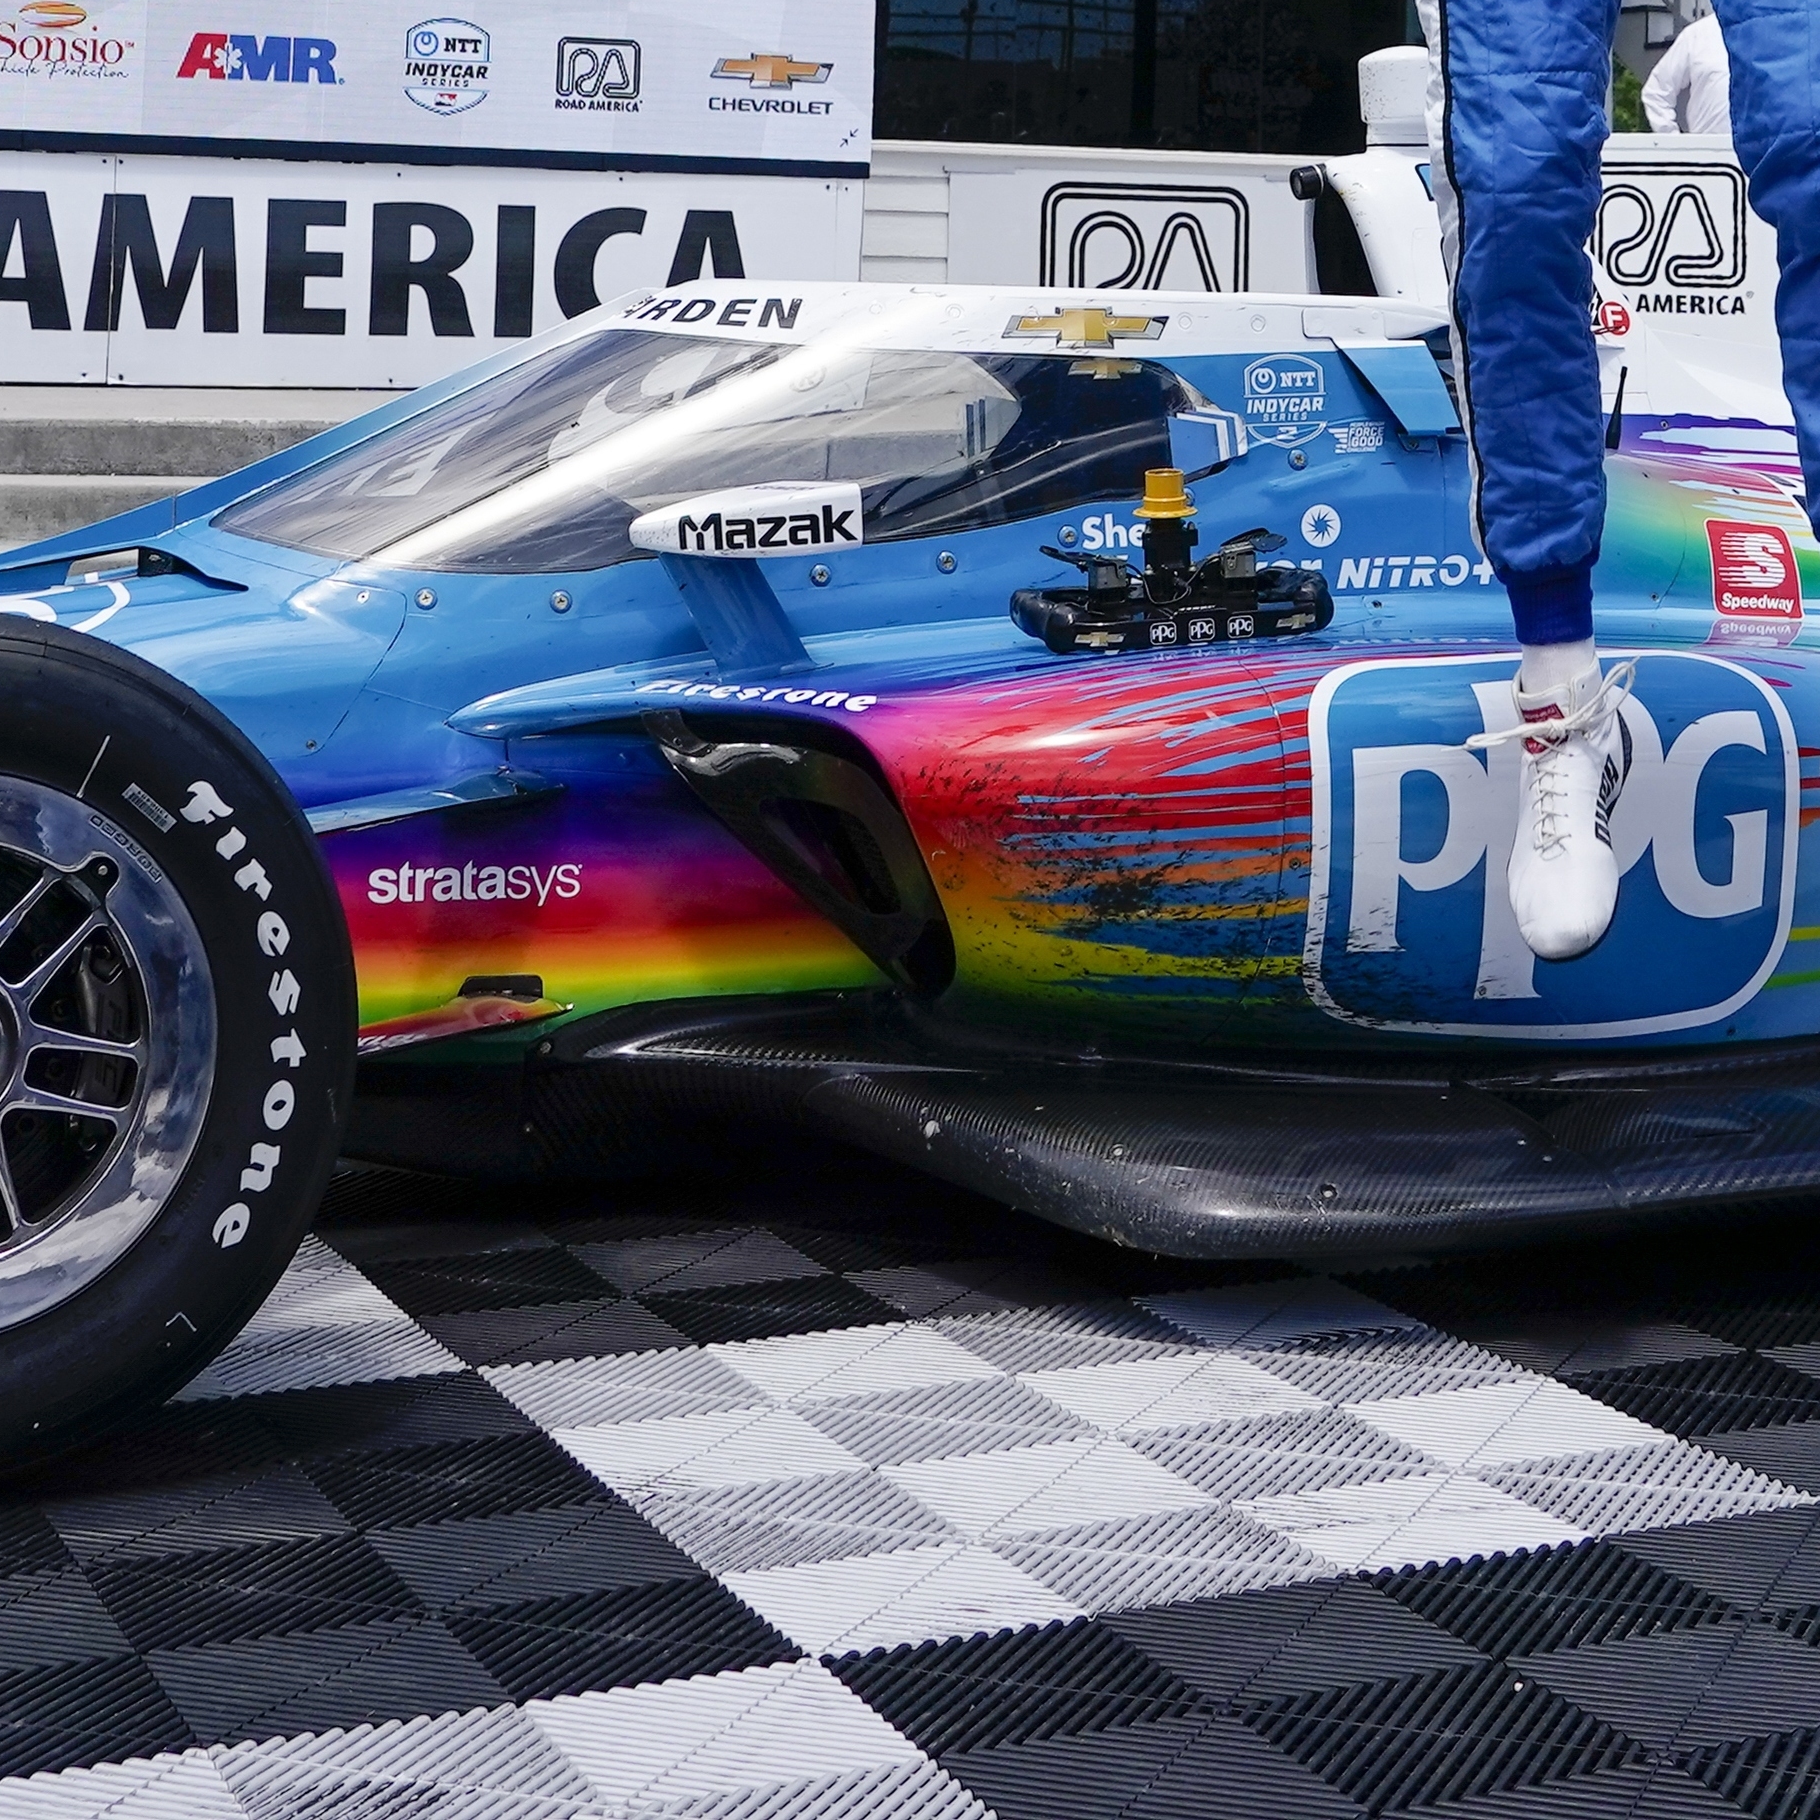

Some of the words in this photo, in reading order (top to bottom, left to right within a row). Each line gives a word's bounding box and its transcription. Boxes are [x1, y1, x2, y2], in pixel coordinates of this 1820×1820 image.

[444, 38, 482, 53] NTT
[176, 33, 336, 84] AMR
[406, 63, 488, 80] INDYCAR
[555, 99, 586, 110] ROAD
[588, 100, 639, 112] AMERICA
[709, 97, 833, 114] CHEVROLET
[1636, 294, 1746, 315] AMERICA
[1280, 371, 1316, 387] NTT
[1247, 397, 1324, 414] INDYCAR
[1263, 411, 1307, 422] SERIES
[1349, 426, 1385, 437] FORCE
[1351, 436, 1384, 448] GOOD
[678, 505, 859, 551] Mazak
[1082, 514, 1145, 550] She
[1721, 592, 1795, 614] Speedway
[1150, 621, 1177, 646] PPG
[1189, 618, 1216, 641] PPG
[1227, 614, 1254, 638] PPG
[368, 860, 581, 906] stratasys
[179, 779, 310, 1250] Firestone
